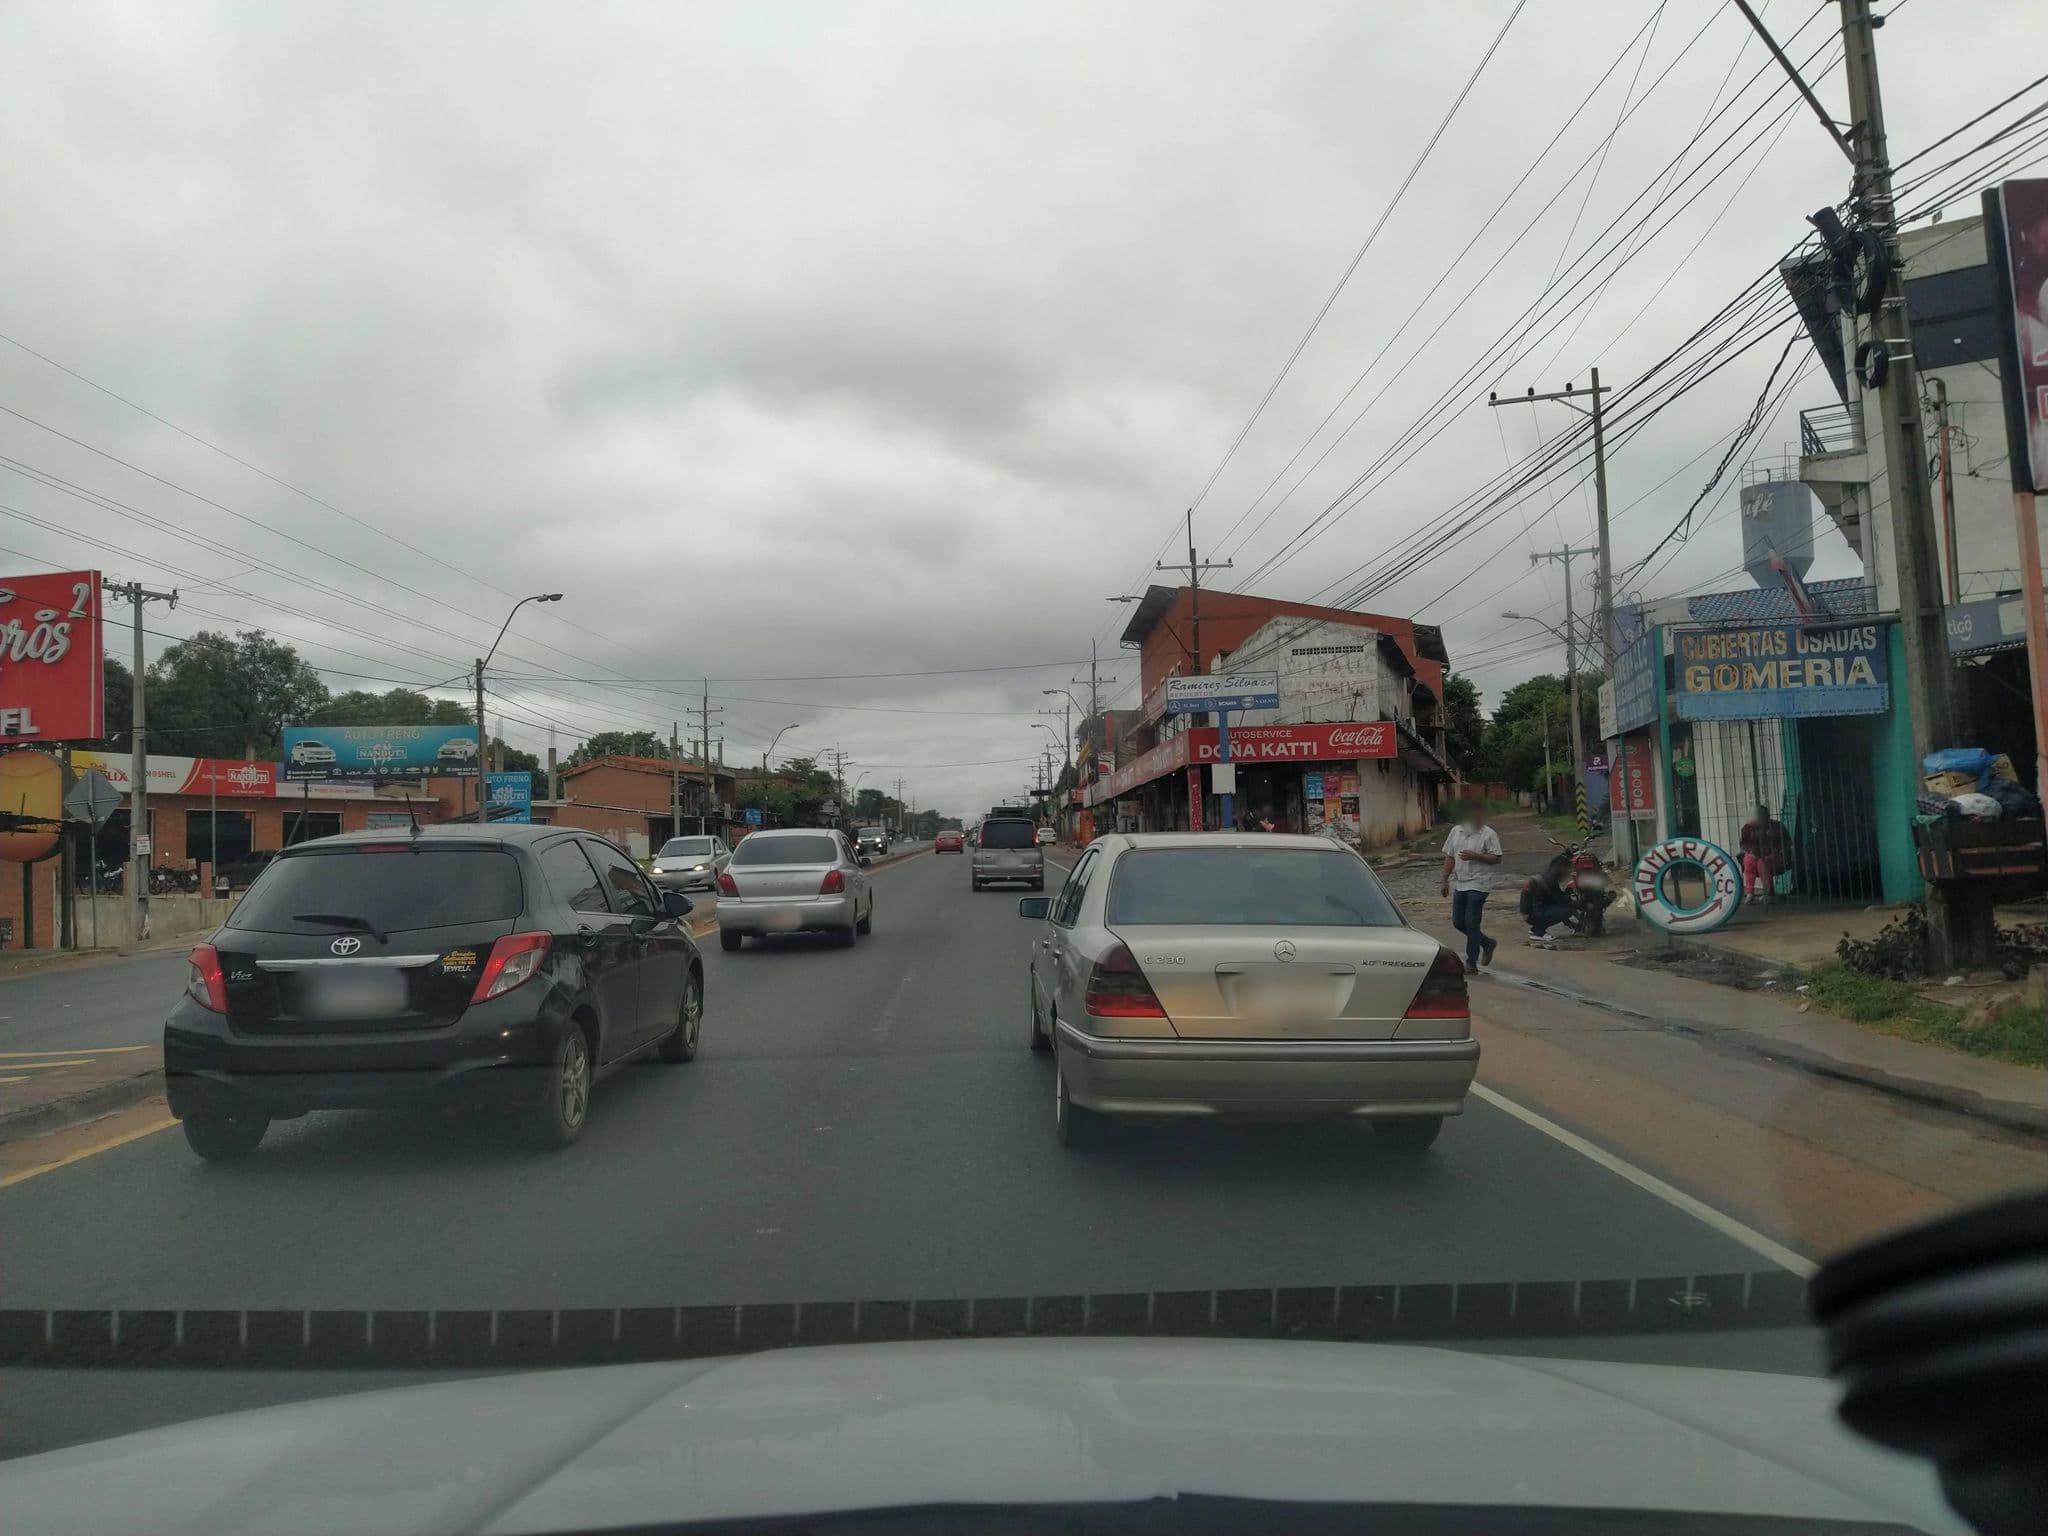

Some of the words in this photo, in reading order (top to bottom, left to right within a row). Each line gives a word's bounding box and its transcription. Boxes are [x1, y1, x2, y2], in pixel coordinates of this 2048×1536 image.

[68, 582, 90, 618] 2
[1681, 630, 1786, 661] CUBIERTAS
[1795, 626, 1877, 653] USADAS
[1685, 655, 1877, 692] GOMERIA
[1262, 742, 1318, 757] KATTI
[1636, 841, 1728, 906] GOMERIA
